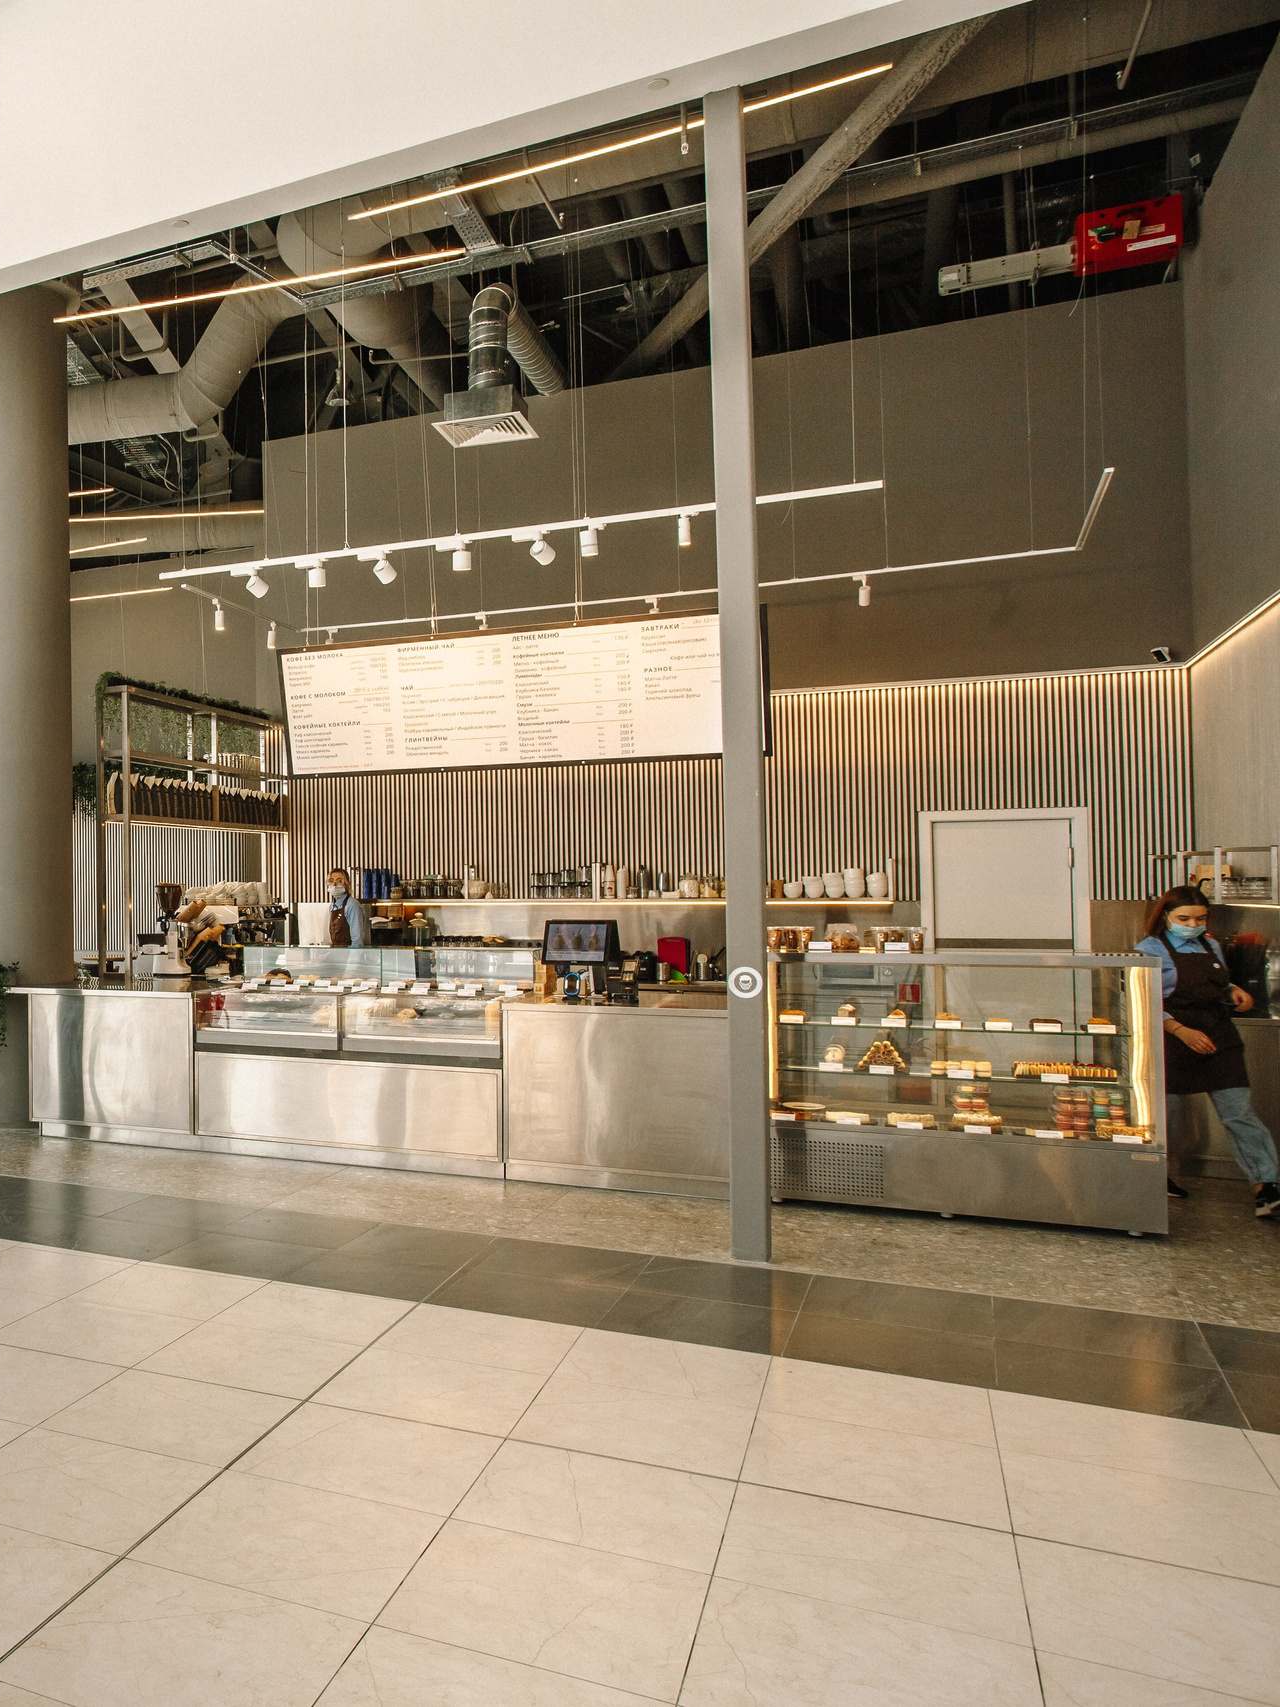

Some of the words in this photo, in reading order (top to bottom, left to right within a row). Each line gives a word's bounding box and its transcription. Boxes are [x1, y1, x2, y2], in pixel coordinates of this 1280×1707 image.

[641, 624, 680, 632] ЗАВТРАКИ
[512, 634, 536, 642] ЛЕТНЕЕ
[397, 644, 439, 652] ФИРМЕННЫЙ
[328, 720, 361, 728] КОКТЕЙЛИ
[405, 735, 448, 743] ГЛИНТВЕЙНЫ
